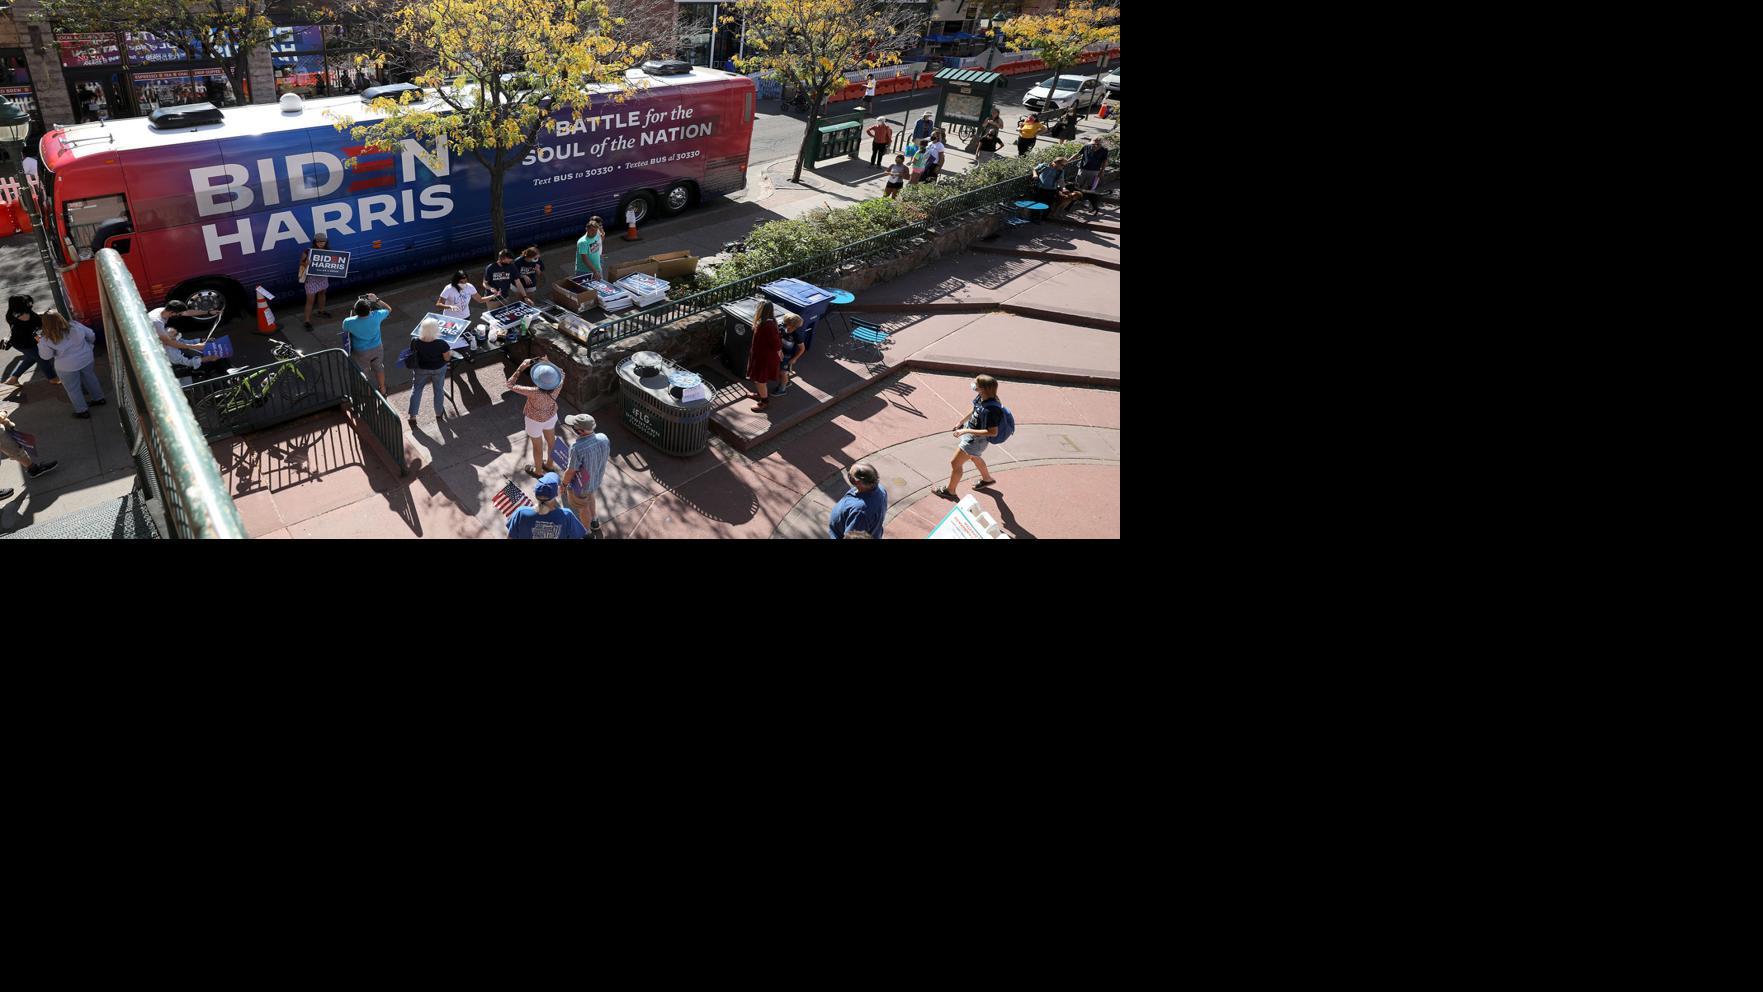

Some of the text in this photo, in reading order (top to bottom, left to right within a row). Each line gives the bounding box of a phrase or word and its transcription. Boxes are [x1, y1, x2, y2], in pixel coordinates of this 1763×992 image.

[557, 106, 693, 137] BATTLE for the
[522, 122, 712, 166] SOUL of the NATION
[190, 135, 450, 217] BIDEN
[532, 177, 552, 187] Text
[553, 172, 574, 183] BUS
[575, 171, 584, 180] to
[585, 165, 614, 178] 30330
[650, 155, 667, 165] BUS
[676, 150, 701, 160] 30330
[202, 185, 454, 262] HARRIS
[311, 261, 345, 270] HARRIS
[312, 254, 347, 264] BIDEN
[437, 319, 463, 331] DEN
